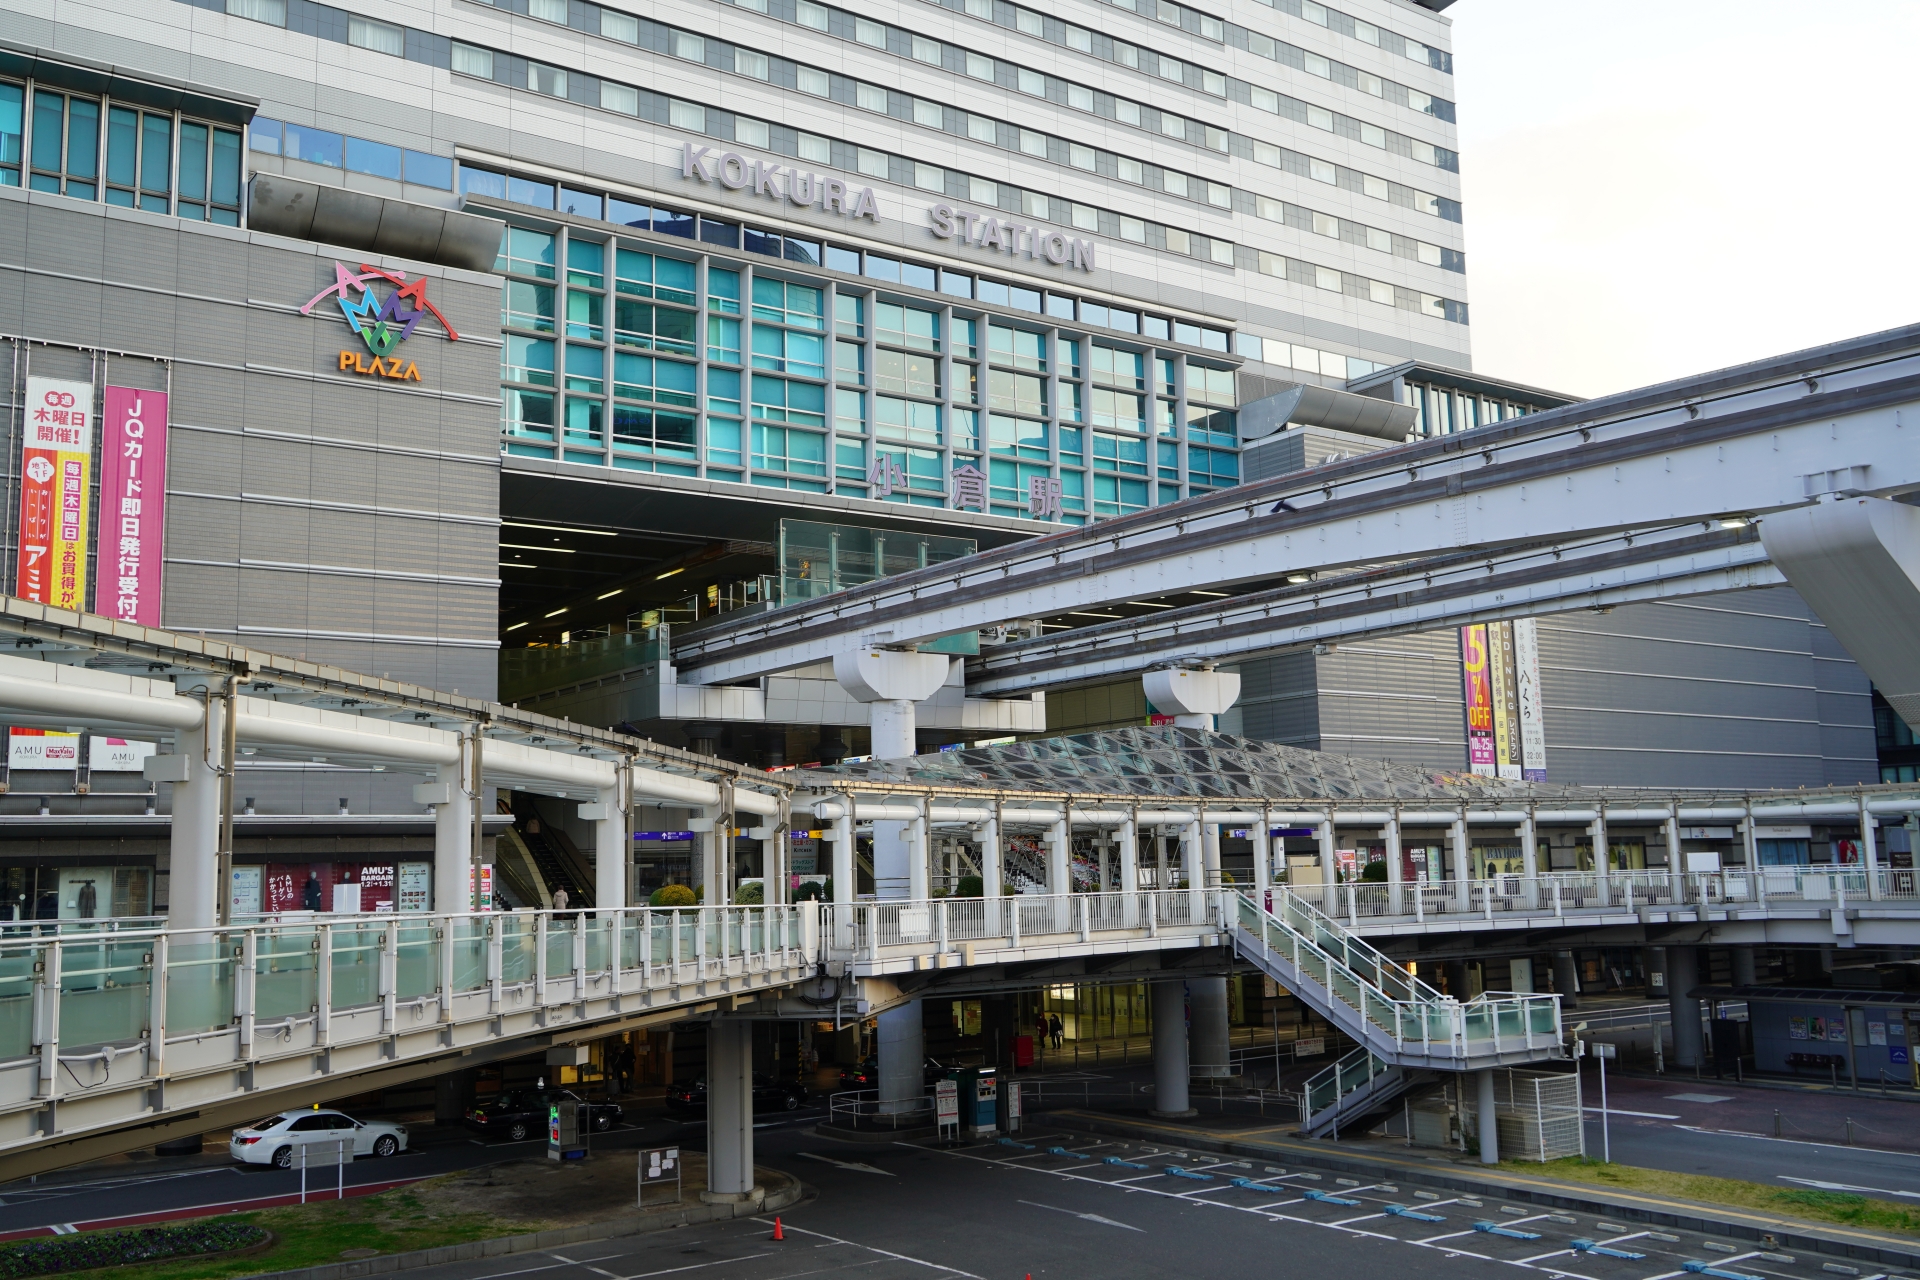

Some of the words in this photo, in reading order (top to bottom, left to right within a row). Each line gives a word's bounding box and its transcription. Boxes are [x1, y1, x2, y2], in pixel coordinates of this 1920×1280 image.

[682, 142, 881, 223] KOKURA
[930, 202, 1096, 273] STATION
[339, 350, 422, 382] PLAZA
[47, 393, 73, 406] 毎週
[33, 407, 85, 427] 木曜日
[867, 452, 1064, 518] 小倉駅
[1469, 706, 1490, 727] OFF
[1509, 720, 1517, 758] レストラン
[14, 746, 42, 755] AMU
[111, 752, 135, 761] AMU
[1502, 769, 1519, 779] AMU
[361, 866, 394, 875] AMU'S
[276, 875, 286, 901] バーゲン
[285, 874, 294, 899] AMUの
